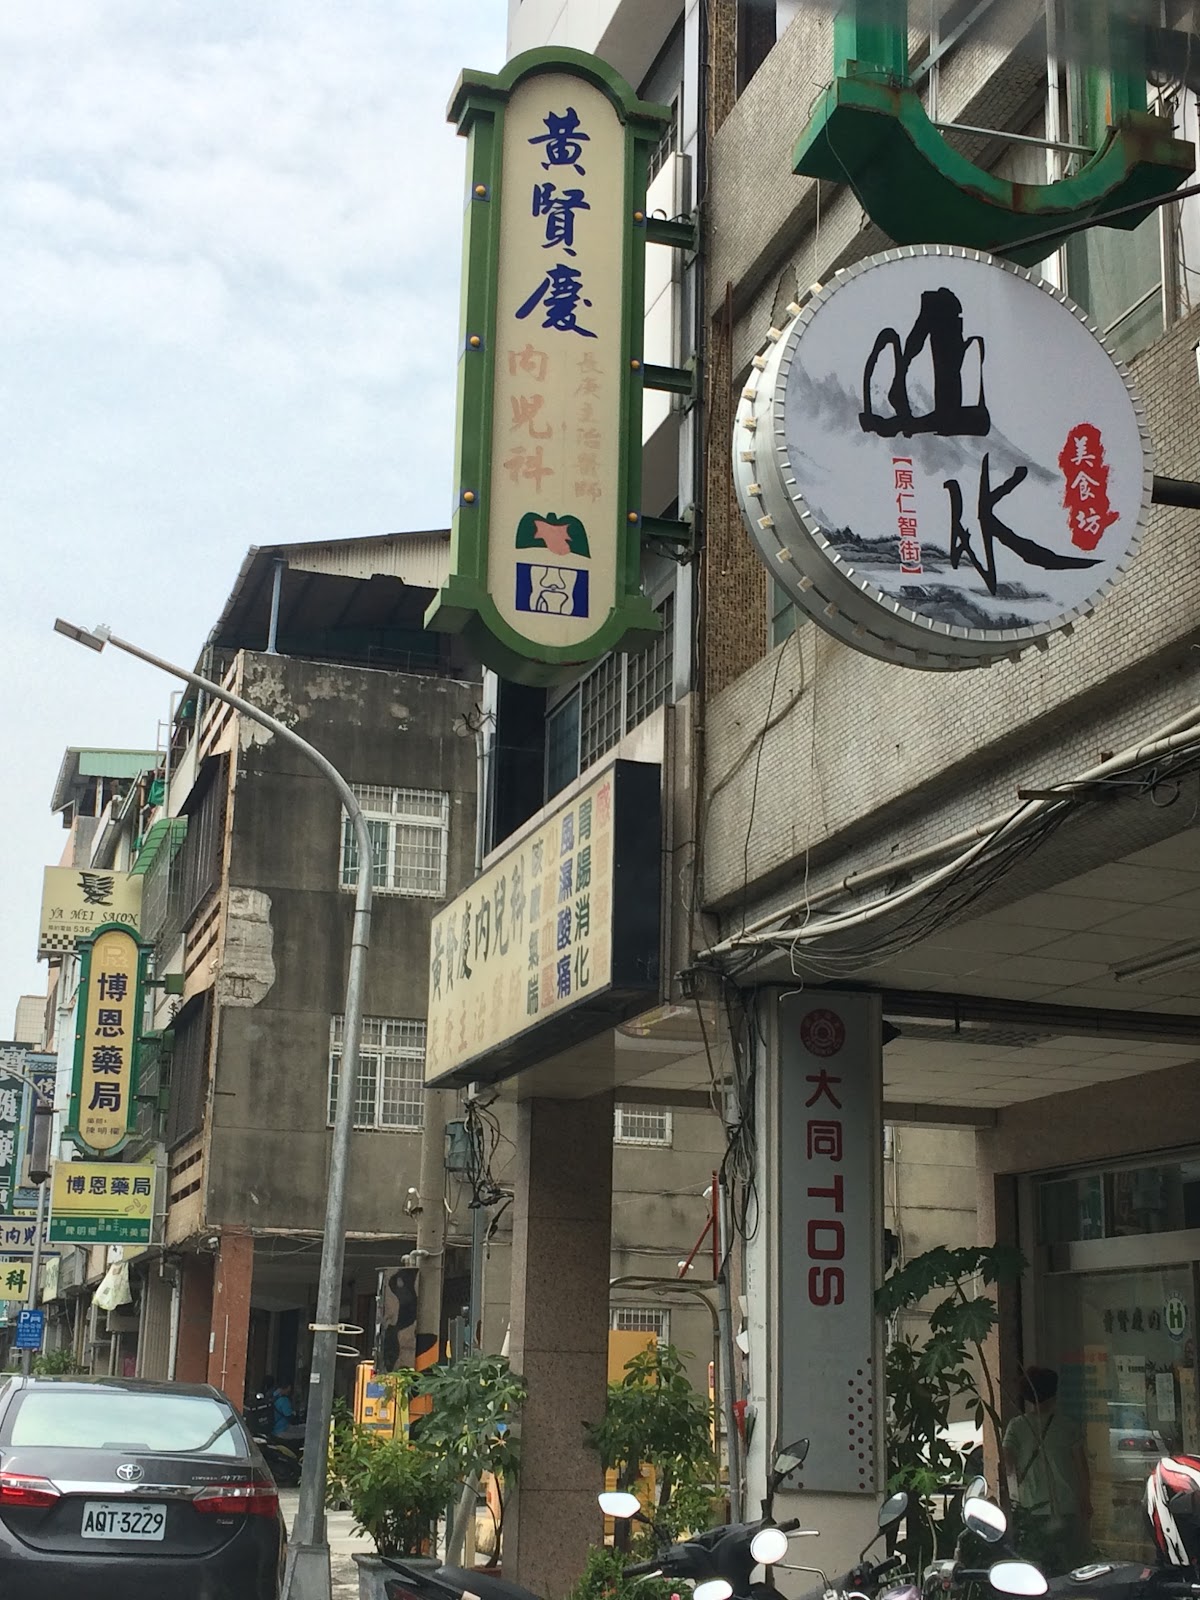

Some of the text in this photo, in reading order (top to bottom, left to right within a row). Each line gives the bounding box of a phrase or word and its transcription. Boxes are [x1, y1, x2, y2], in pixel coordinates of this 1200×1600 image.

[516, 106, 597, 338] 黃賢慶
[1069, 436, 1101, 535] 美食坊
[49, 908, 139, 926] YA MEI SALON
[77, 871, 115, 906] 髮
[574, 796, 592, 991] 胃腸消化
[88, 972, 128, 1113] 博恩藥局
[66, 1175, 151, 1196] 博恩藥局
